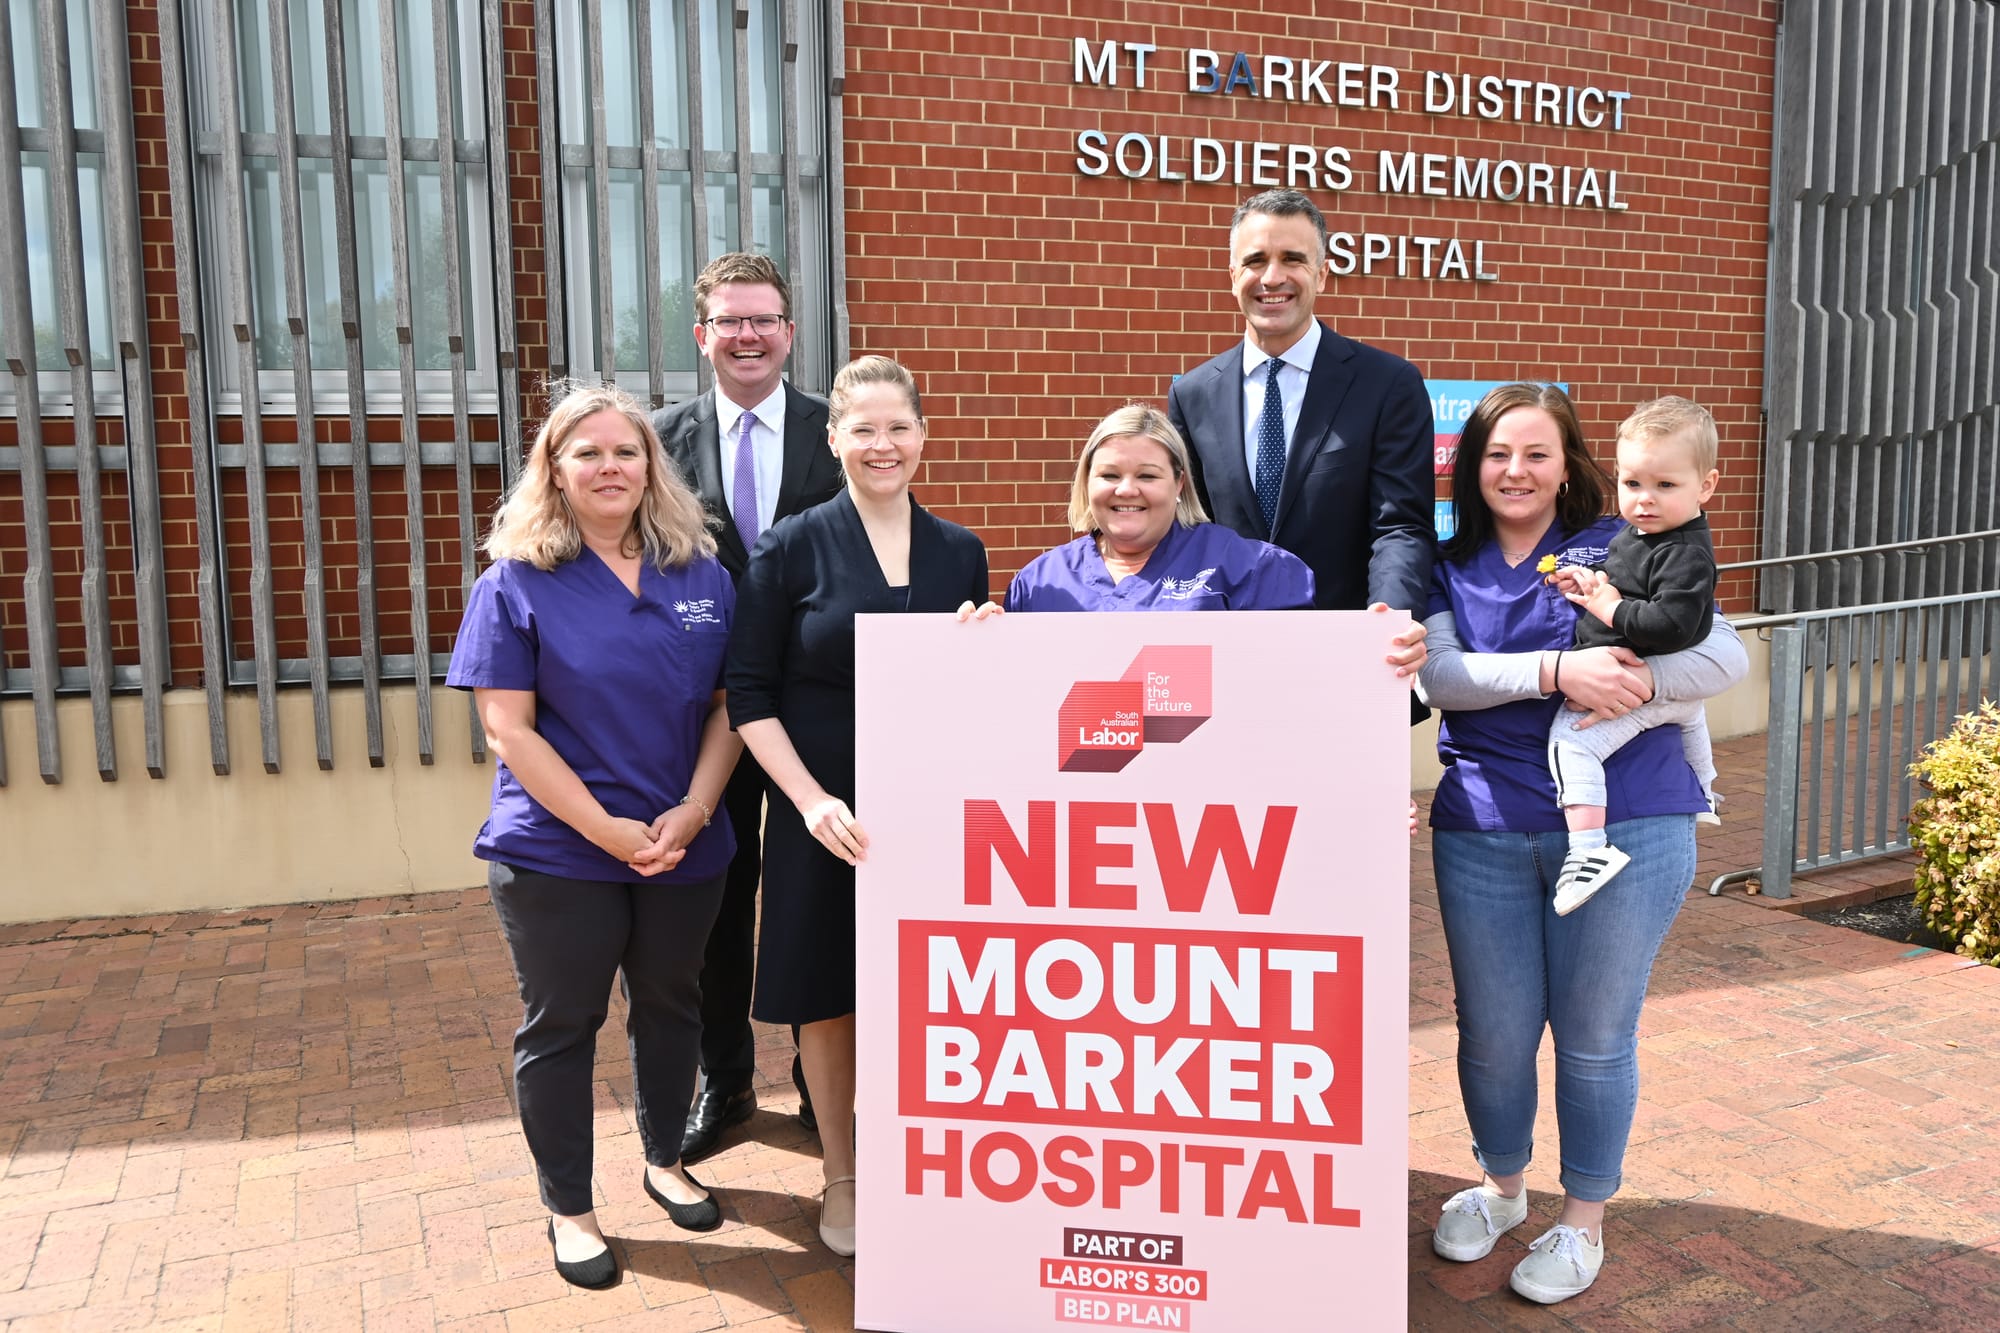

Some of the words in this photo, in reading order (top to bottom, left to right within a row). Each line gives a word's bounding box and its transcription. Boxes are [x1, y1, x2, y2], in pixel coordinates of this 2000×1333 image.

[1074, 37, 1157, 89] MT
[1188, 48, 1400, 110] BARKER
[1425, 71, 1631, 130] DISTRICT
[1076, 129, 1353, 191] SOLDIERS
[1379, 150, 1629, 210] MEMORIAL
[1327, 231, 1498, 281] SPITAL
[1147, 672, 1170, 685] For
[1147, 686, 1170, 698] the
[1115, 711, 1139, 719] South
[1147, 699, 1192, 712] Future
[1079, 727, 1139, 746] Labor
[1100, 718, 1139, 727] Australian
[964, 799, 1298, 915] NEW
[928, 935, 1338, 1032] MOUNT
[925, 1026, 1335, 1127] BARKER
[905, 1127, 1361, 1228] HOSPITAL
[1073, 1233, 1135, 1257] PART
[1139, 1239, 1174, 1260] OF
[1155, 1275, 1200, 1296] 300
[1064, 1298, 1110, 1321] BED
[1116, 1302, 1181, 1327] PLAN
